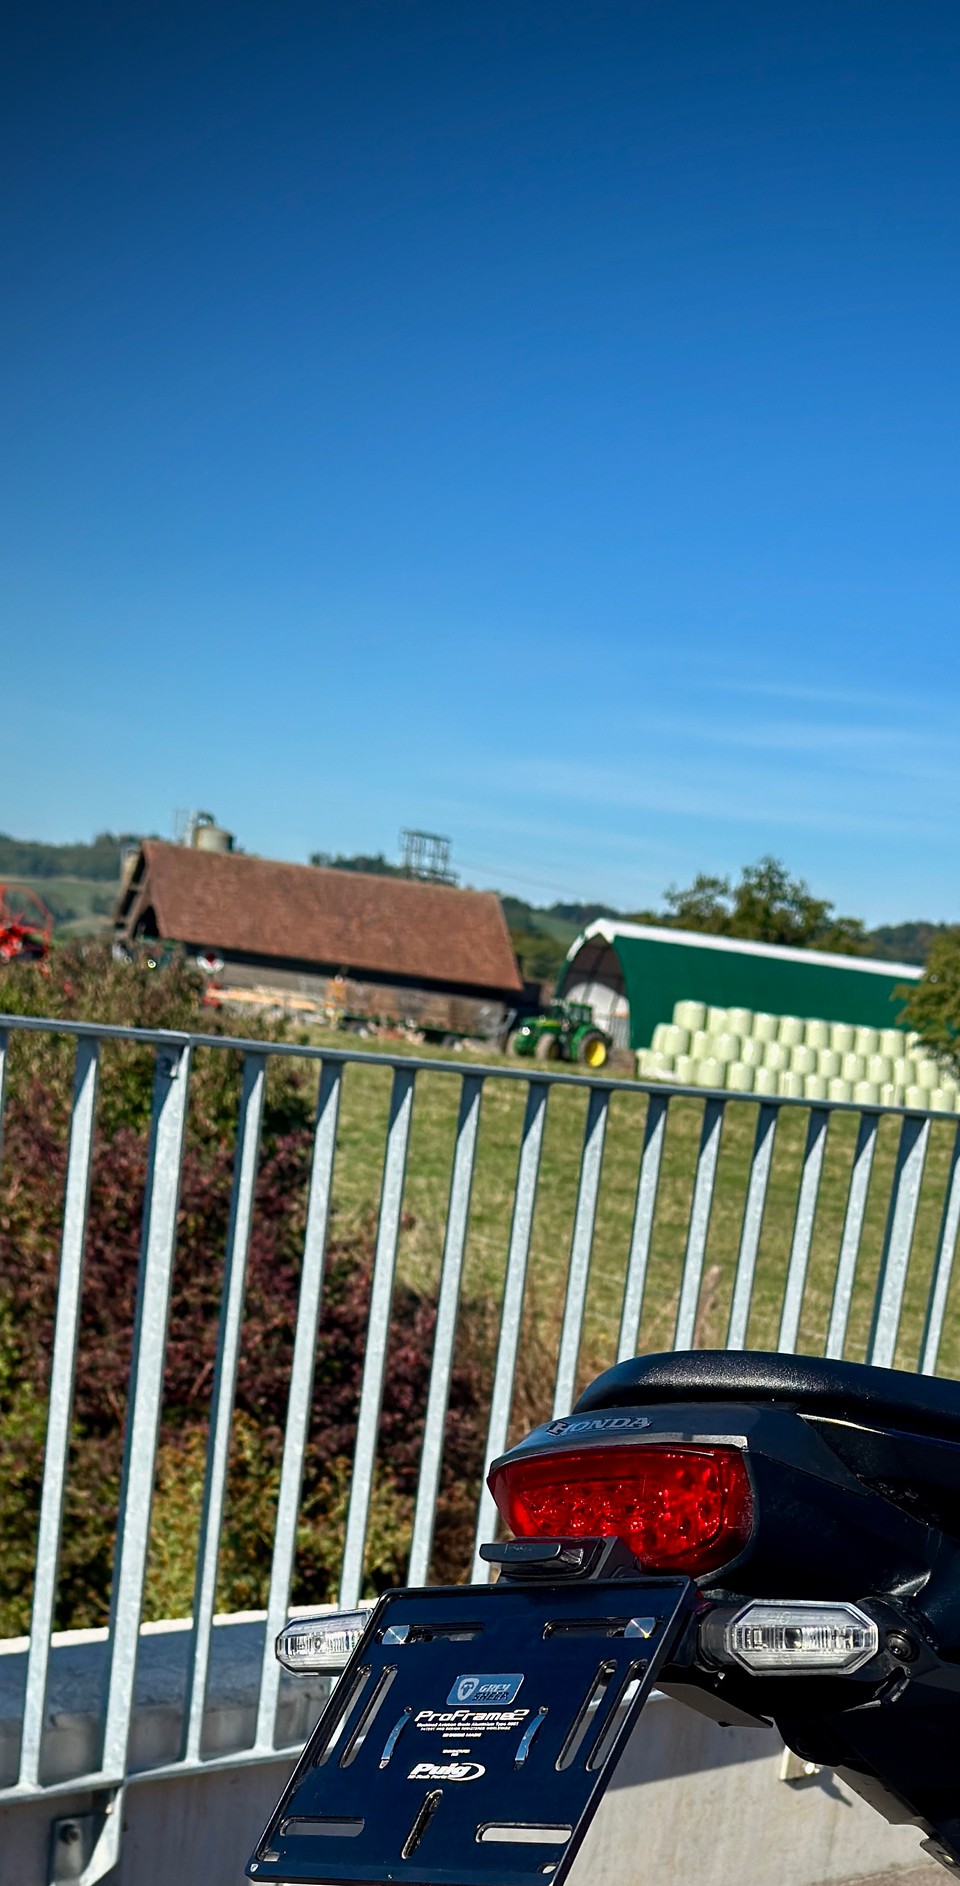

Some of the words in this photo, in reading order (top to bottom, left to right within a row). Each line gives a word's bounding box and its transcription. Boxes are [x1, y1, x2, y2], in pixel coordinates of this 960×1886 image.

[547, 1417, 652, 1436] HONDA
[479, 1683, 511, 1692] GREY
[414, 1708, 530, 1722] ProFrame2
[410, 1763, 472, 1778] Puig
